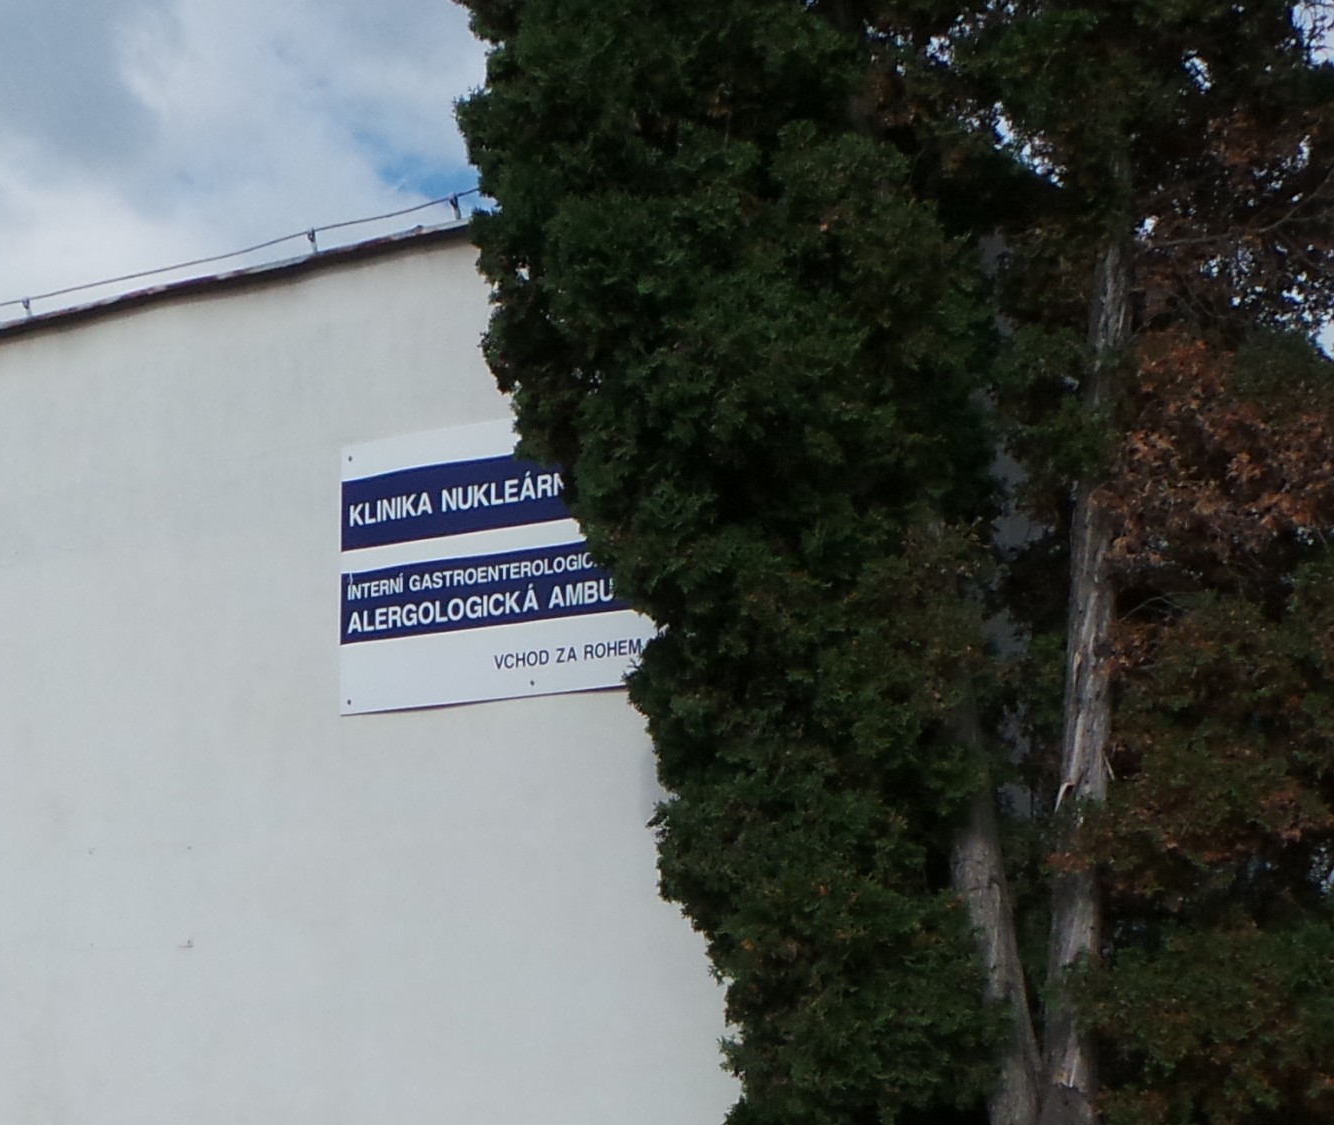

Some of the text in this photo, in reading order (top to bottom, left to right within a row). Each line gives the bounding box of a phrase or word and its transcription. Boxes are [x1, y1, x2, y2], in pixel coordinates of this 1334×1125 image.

[349, 492, 432, 527] KLINIKA
[347, 551, 598, 600] INTERNÍ GASTROENTEROLOGIC
[347, 583, 539, 634] ALERGOLOGICKÁ
[494, 639, 642, 670] VCHOD ZA ROHEM
